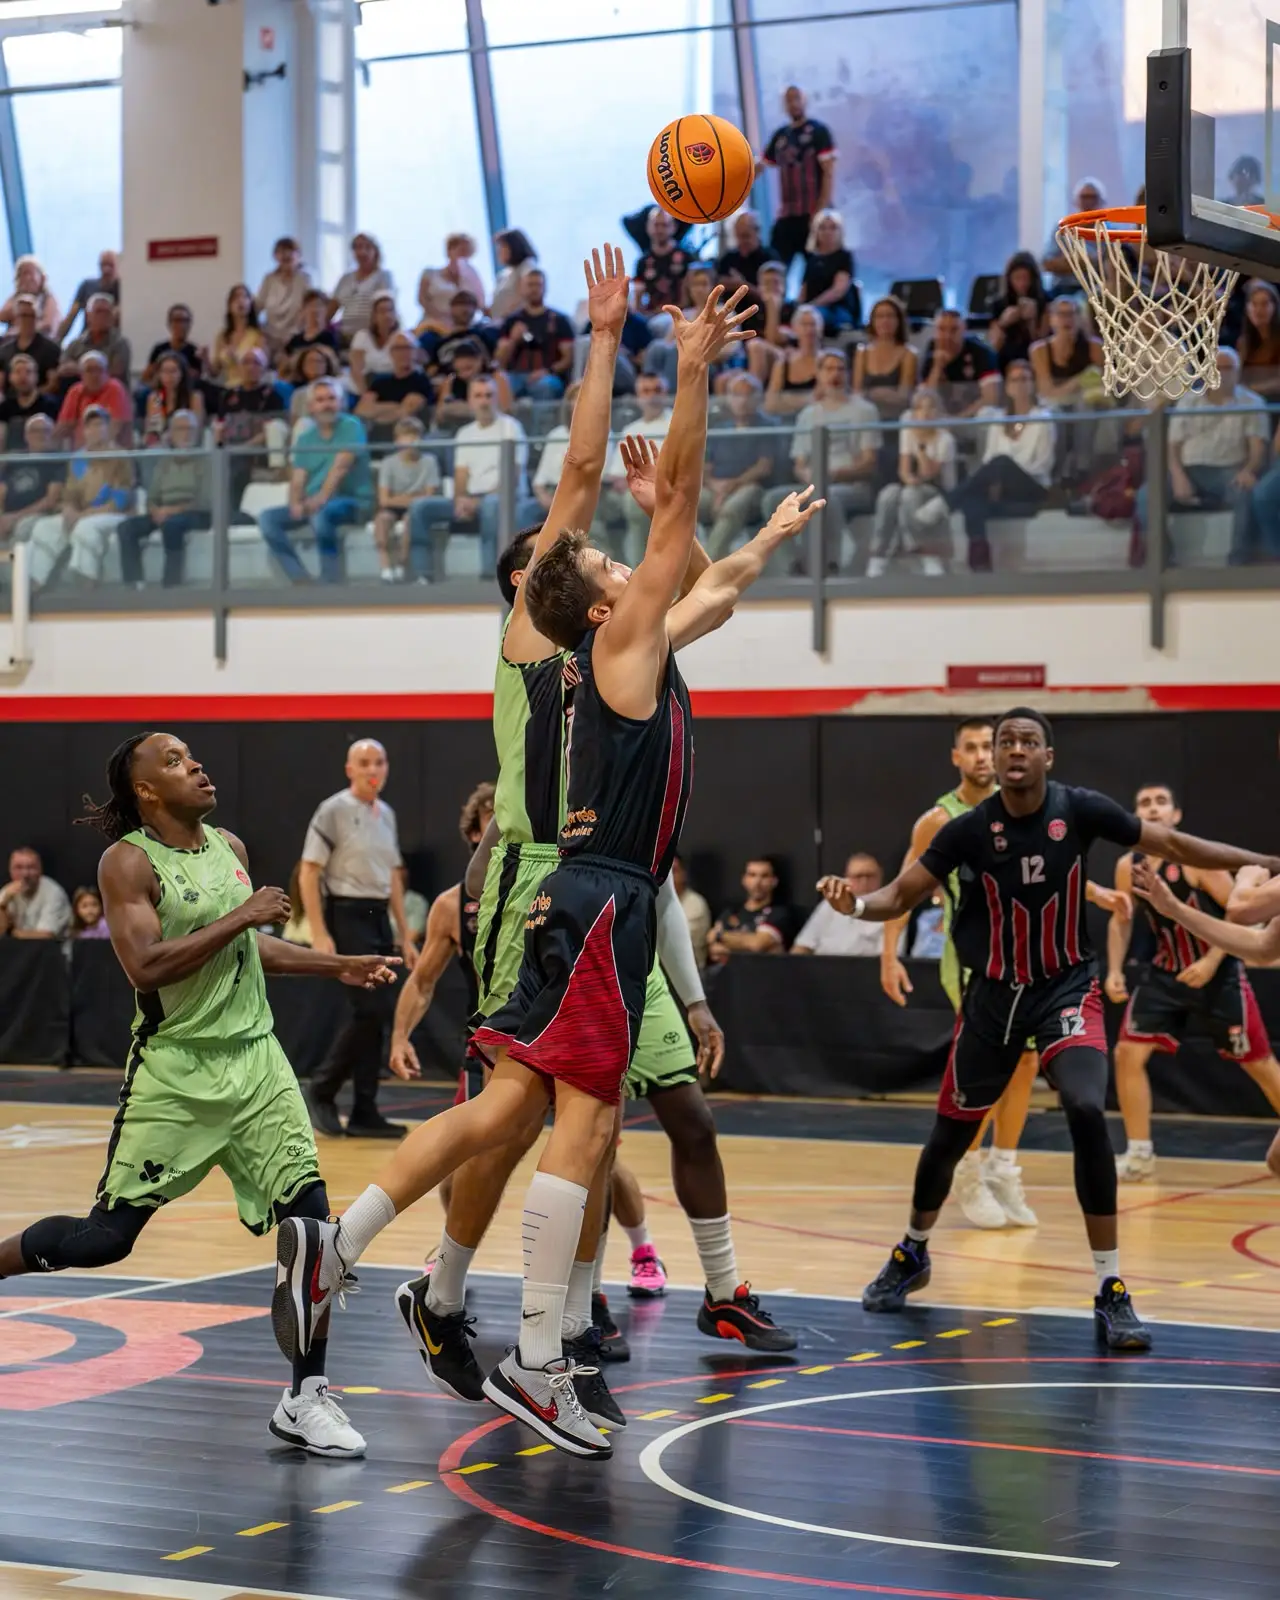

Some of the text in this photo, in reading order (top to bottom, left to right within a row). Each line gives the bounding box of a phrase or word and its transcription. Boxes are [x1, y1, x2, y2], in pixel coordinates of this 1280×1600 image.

[657, 130, 684, 203] Wilson
[1020, 854, 1046, 885] 12
[1059, 1015, 1087, 1037] 12
